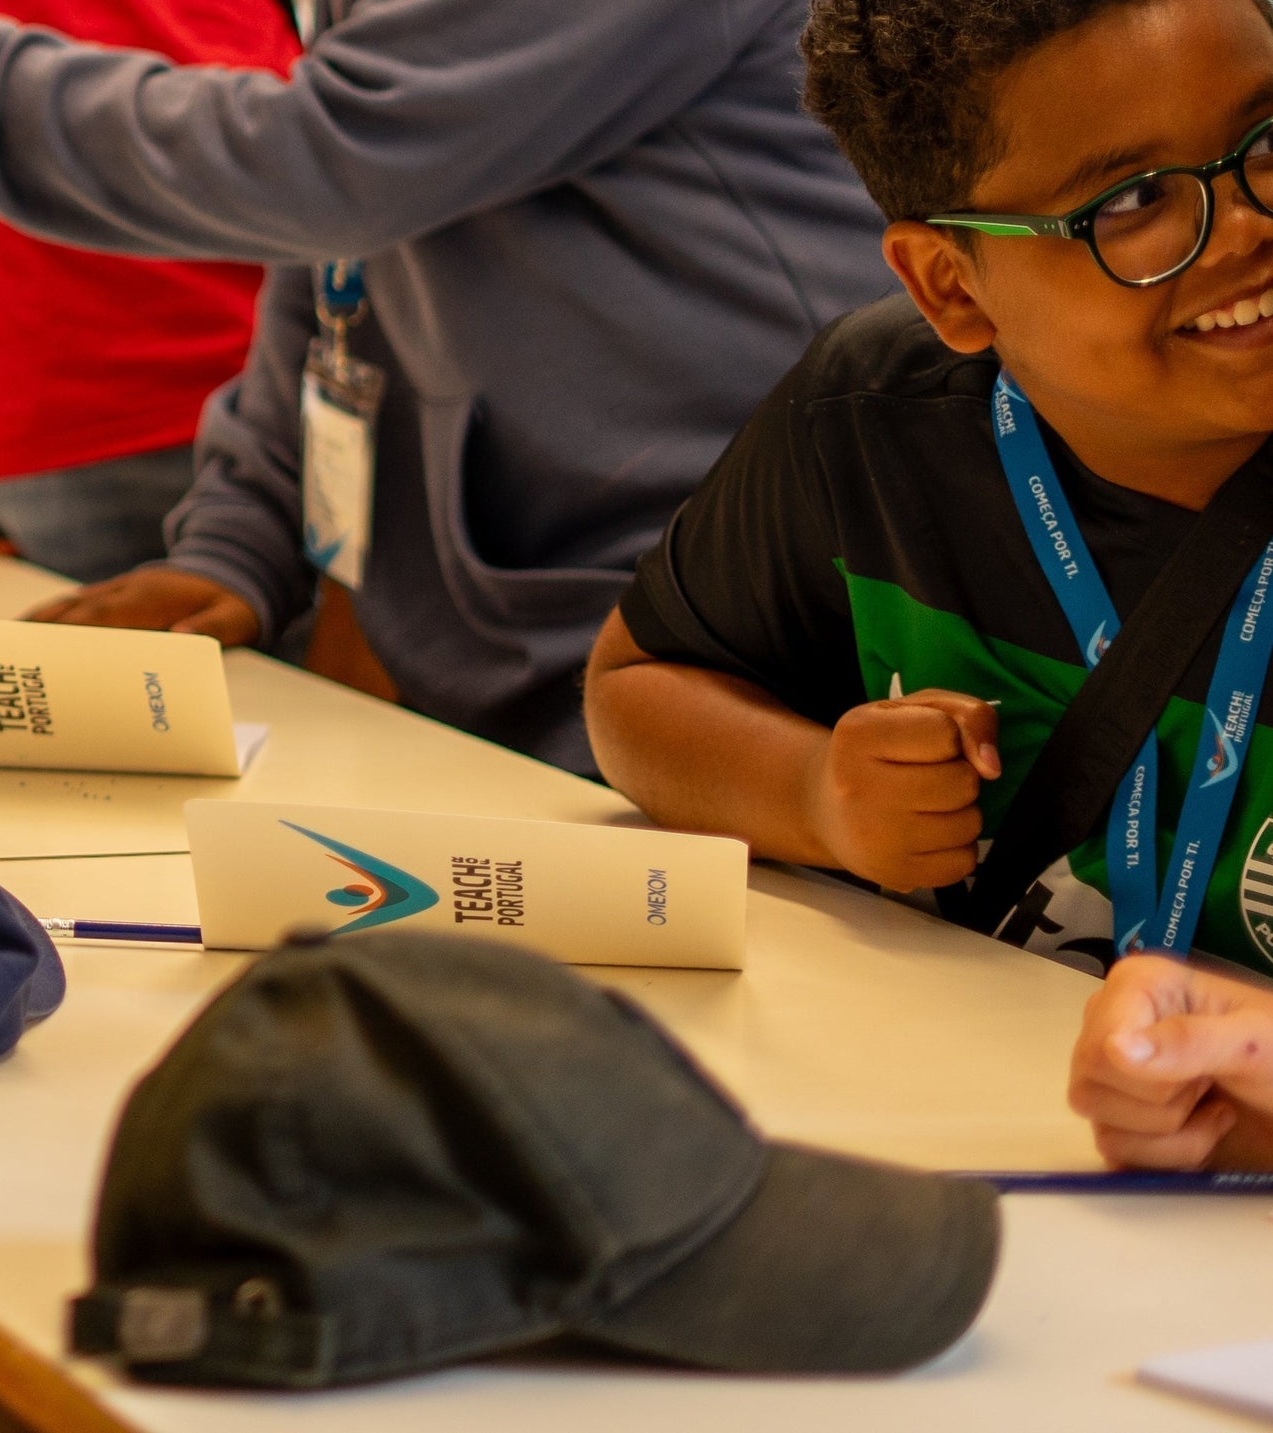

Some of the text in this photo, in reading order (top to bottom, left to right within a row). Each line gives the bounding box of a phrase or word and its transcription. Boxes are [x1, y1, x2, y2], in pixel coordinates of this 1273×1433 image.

[1028, 475, 1079, 579] COMEÇA POR TI.
[1240, 587, 1267, 642] COMEÇA
[1258, 557, 1273, 585] POR
[19, 666, 54, 736] PORTUGAL
[143, 672, 169, 732] OMEXOM
[1223, 695, 1242, 738] TEACH
[1234, 693, 1254, 742] PORTUGAL
[1127, 765, 1145, 817] COMEÇA
[1126, 820, 1139, 849] POR
[451, 855, 493, 924] TEACH FOR
[495, 861, 524, 926] PORTUGAL
[647, 869, 667, 926] OMEXOM
[1163, 840, 1201, 948] COMEÇA POR TI.
